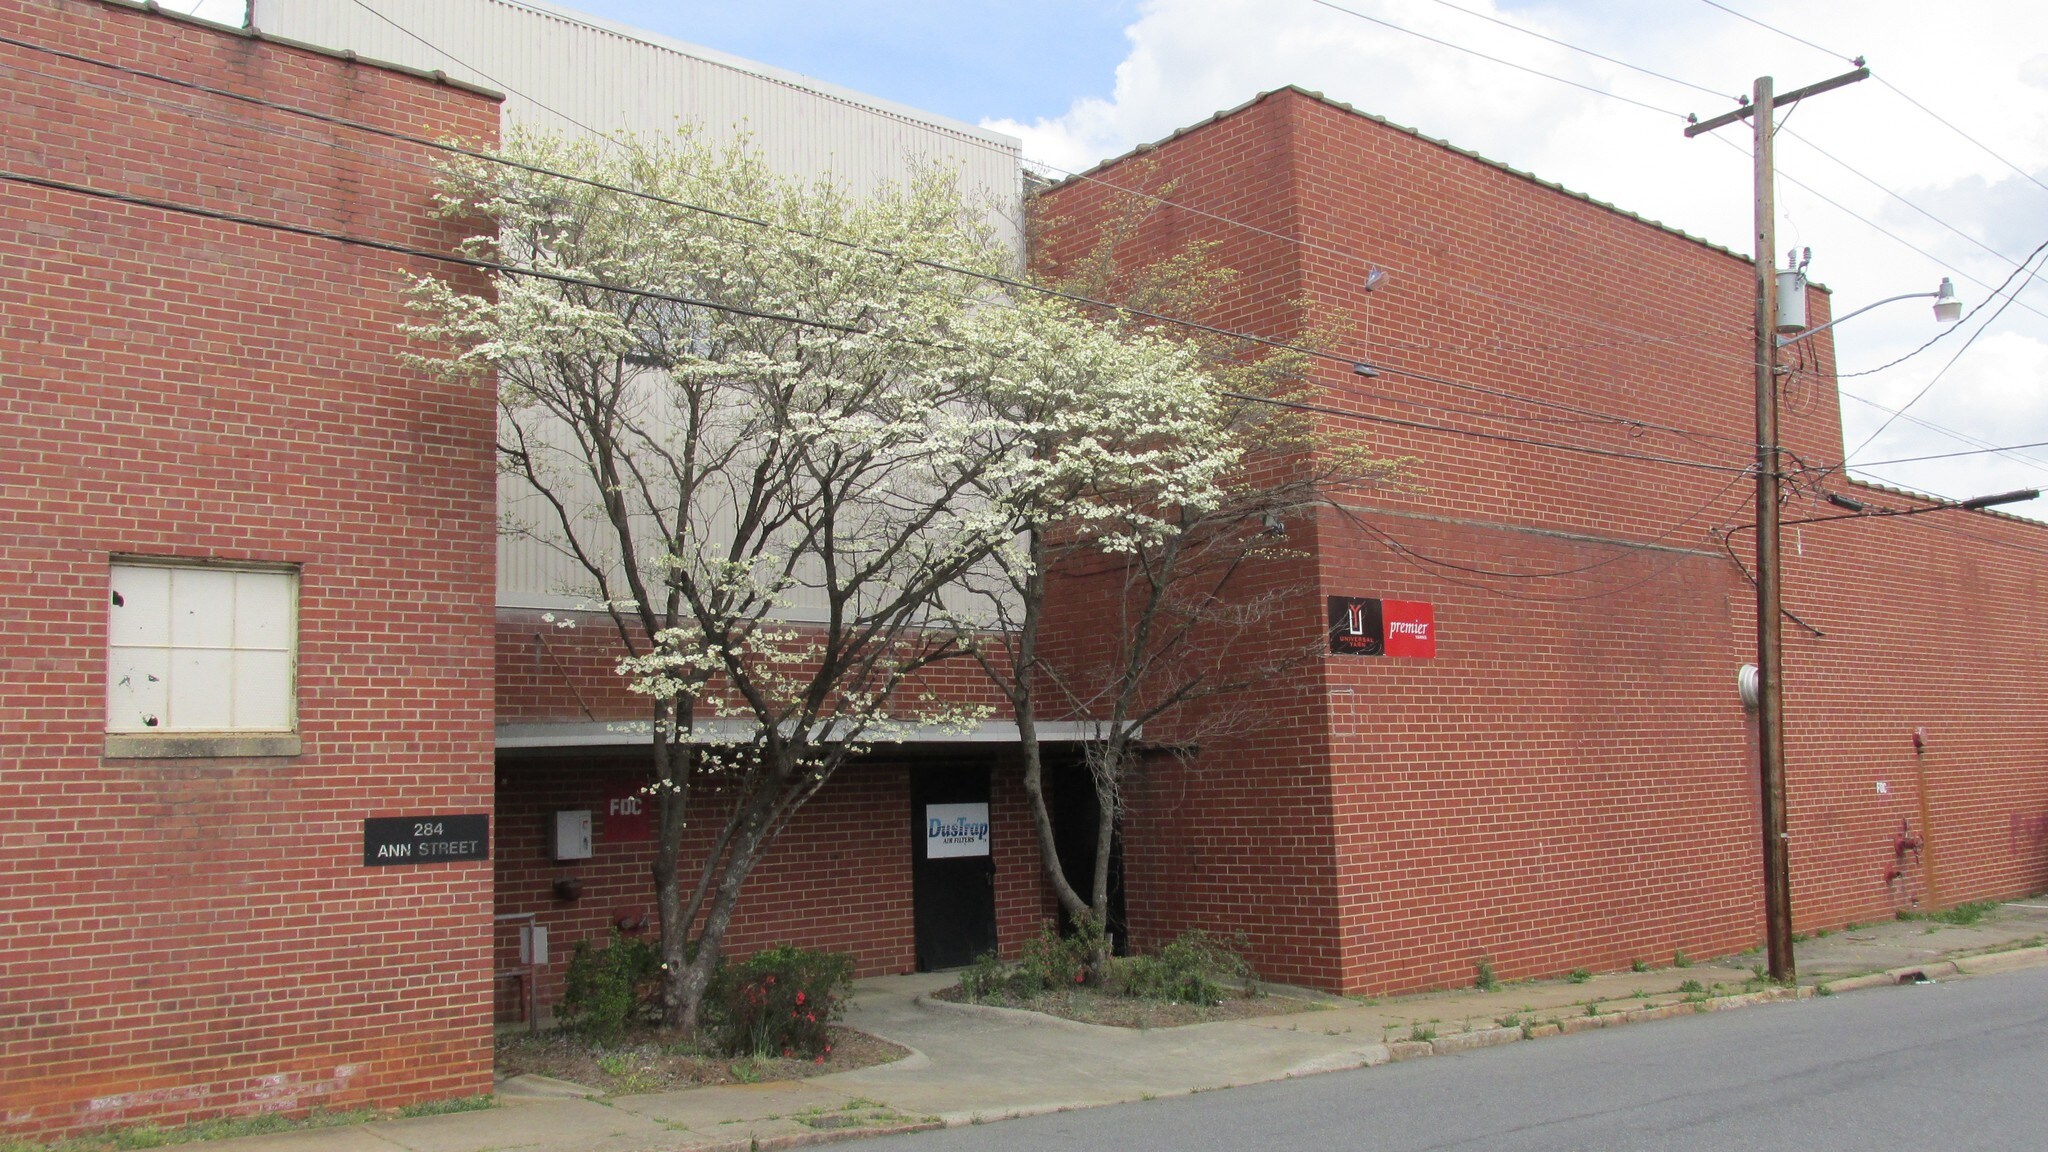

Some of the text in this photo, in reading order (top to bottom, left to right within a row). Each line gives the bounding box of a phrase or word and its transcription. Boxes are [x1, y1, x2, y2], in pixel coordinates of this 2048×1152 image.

[1389, 619, 1428, 640] premier
[610, 798, 642, 816] FDC
[414, 822, 444, 837] 284
[928, 816, 988, 840] DusTrap
[377, 840, 479, 858] ANN STREET
